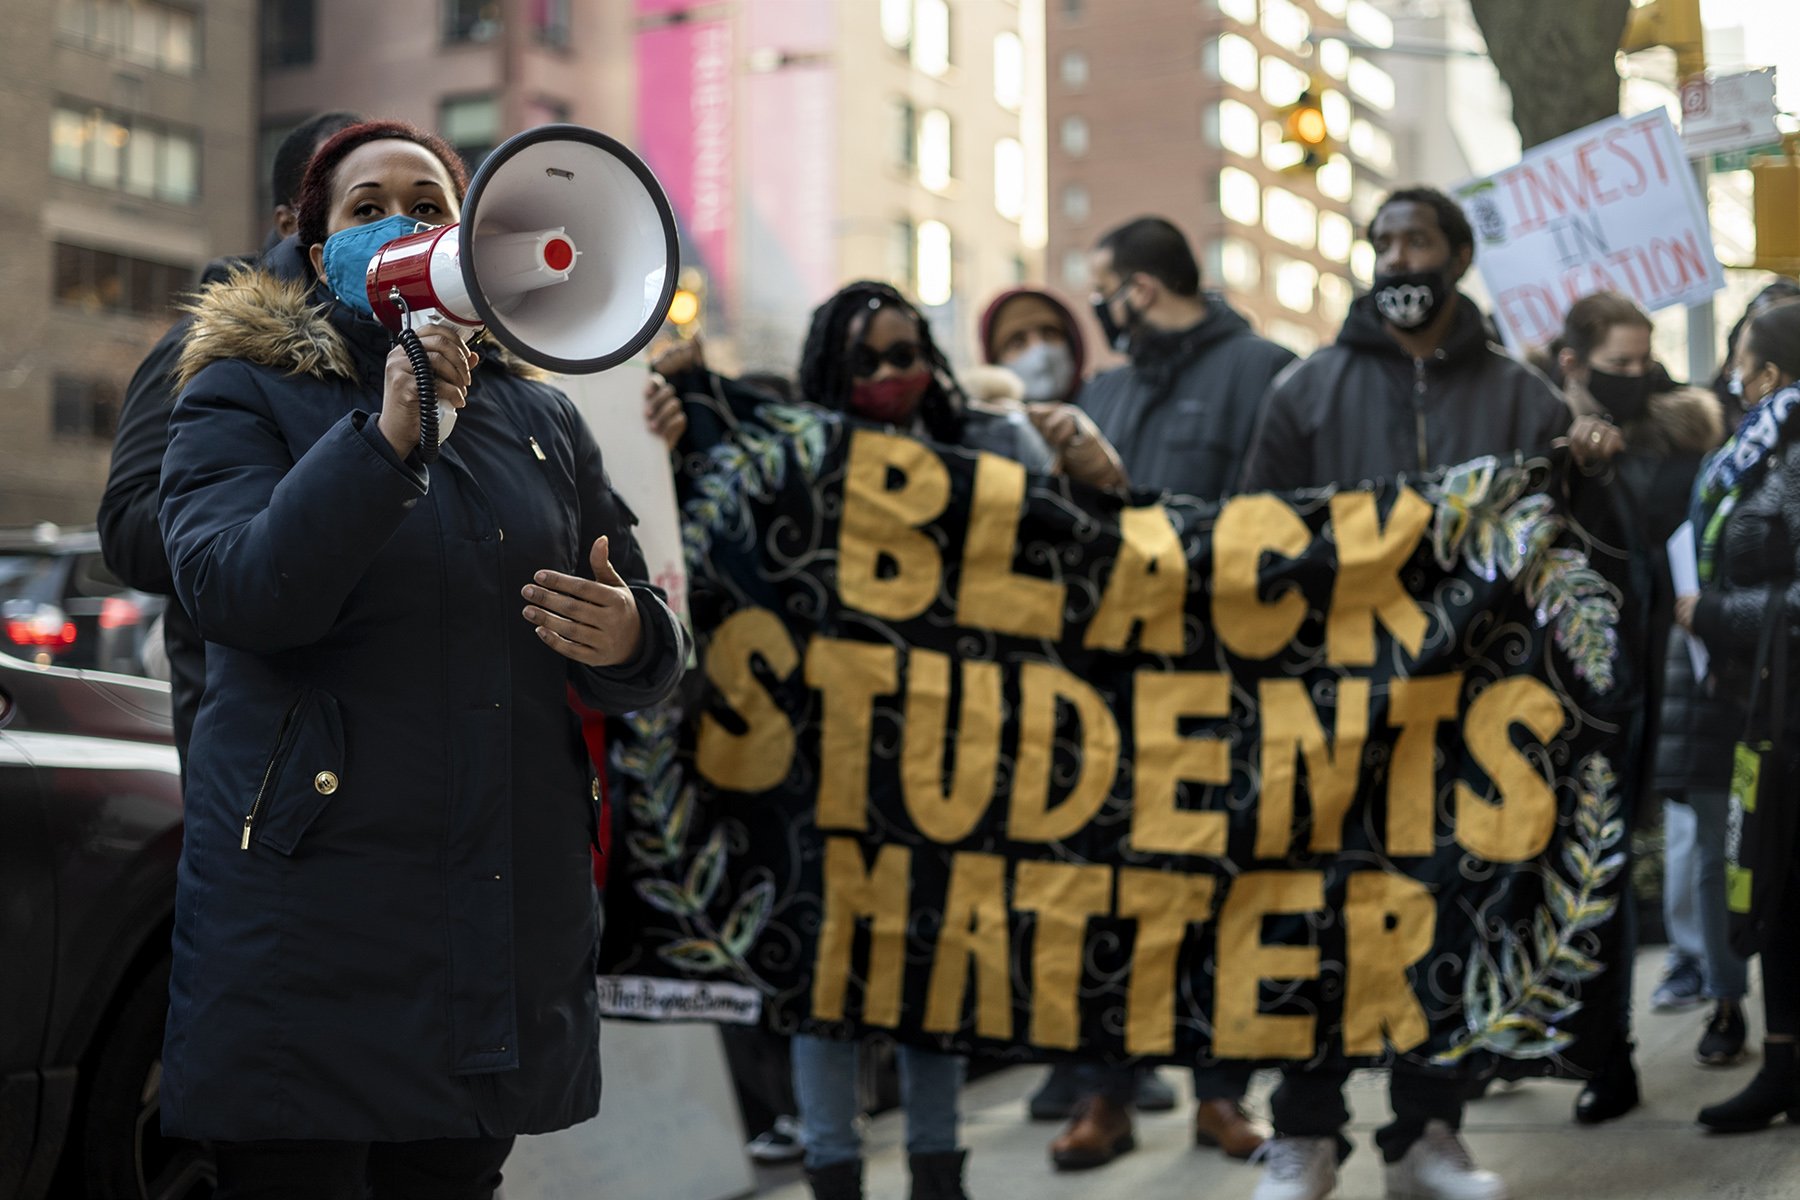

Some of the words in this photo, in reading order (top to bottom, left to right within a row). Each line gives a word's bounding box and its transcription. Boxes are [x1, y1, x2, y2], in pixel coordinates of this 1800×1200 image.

[1499, 117, 1671, 240] INVEST
[1545, 205, 1612, 270] IN
[836, 429, 1435, 667] BLACK
[696, 608, 1566, 864] STUDENTS
[812, 838, 1438, 1060] MATTER
